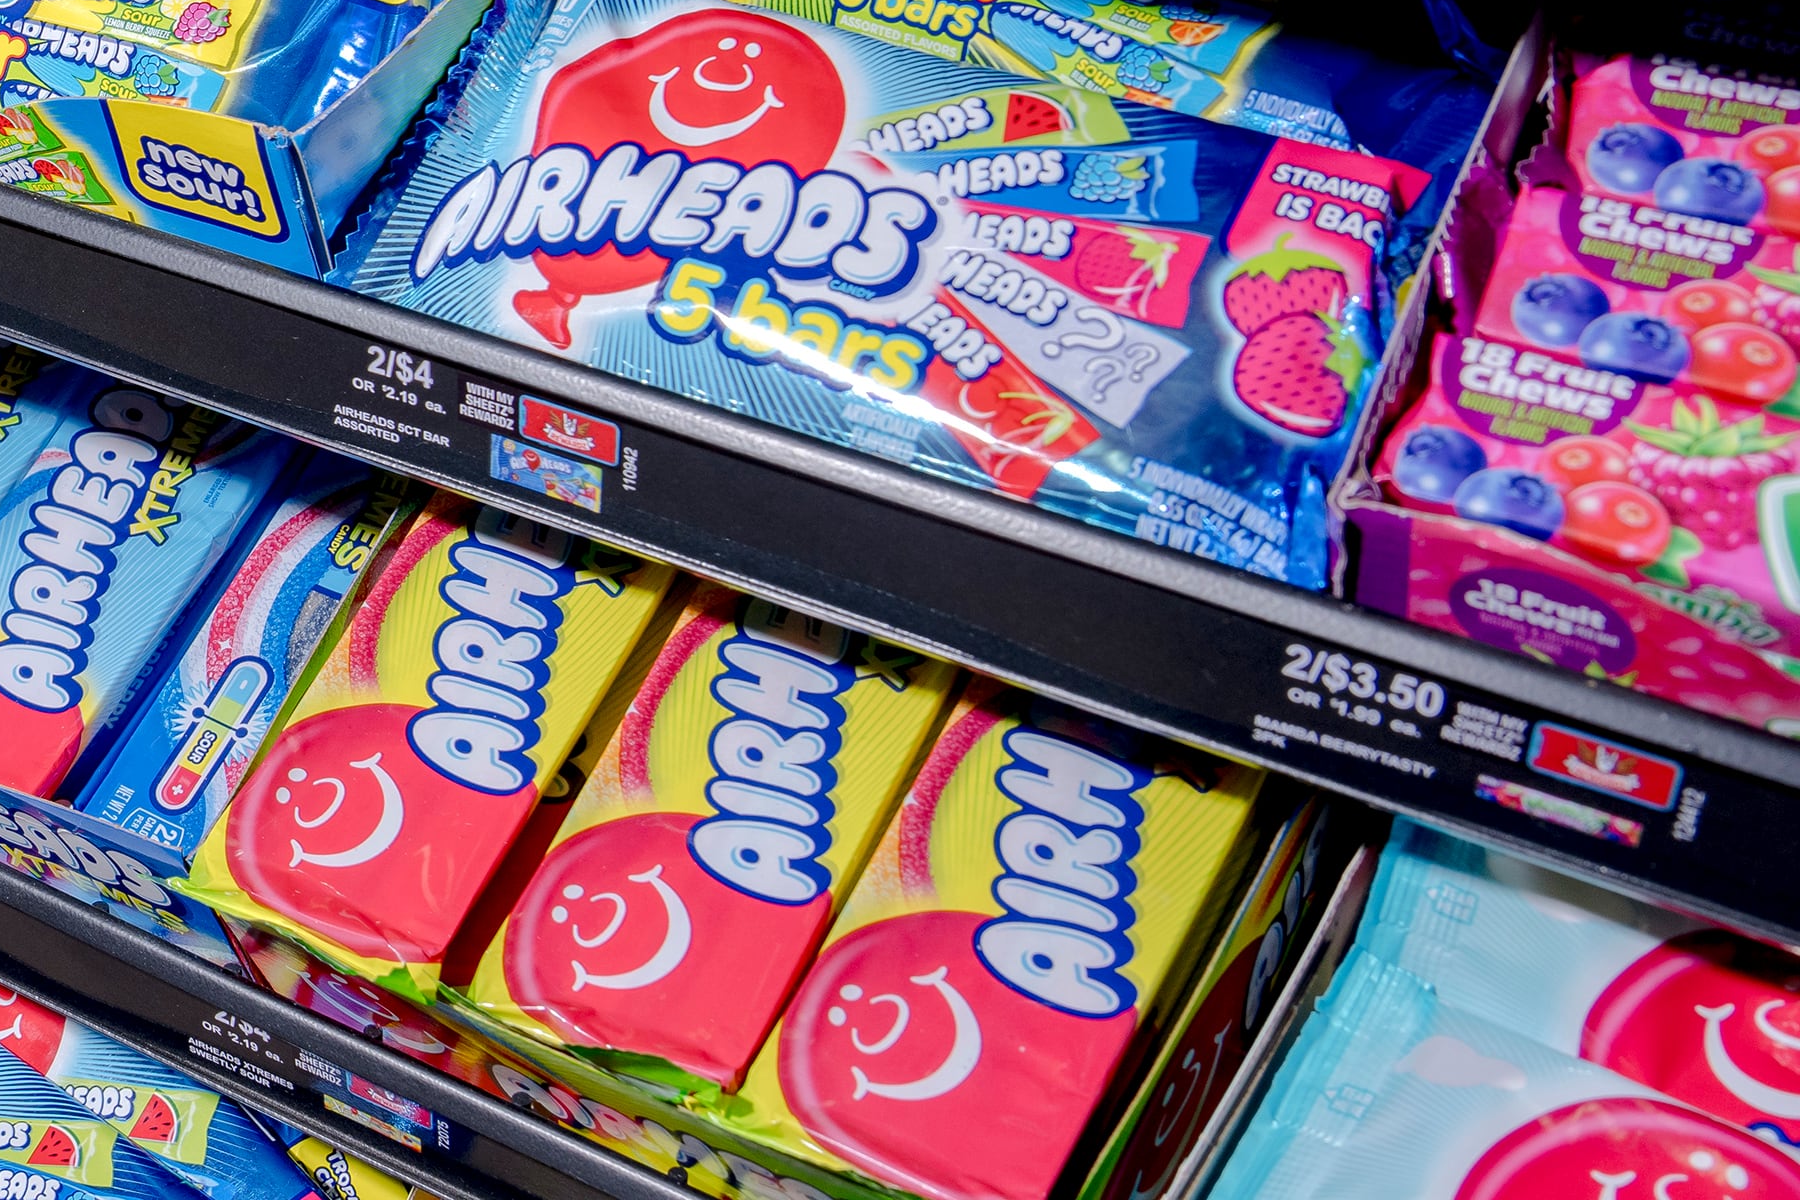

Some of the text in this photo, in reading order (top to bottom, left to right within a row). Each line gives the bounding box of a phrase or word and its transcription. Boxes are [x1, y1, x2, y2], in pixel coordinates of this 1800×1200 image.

[839, 14, 960, 59] ASSORTED FLAVORS
[146, 136, 242, 190] new
[143, 163, 260, 218] sour!
[418, 145, 924, 283] AIRHEADS
[1276, 195, 1384, 247] IS BAC
[658, 260, 928, 393] 5 bars
[352, 377, 376, 394] OR
[366, 344, 434, 391] 2/$4
[1459, 336, 1638, 400] 18 Fruit
[1458, 366, 1616, 421] Chews
[333, 404, 396, 431] AIRHEADS
[422, 430, 450, 448] BAR
[333, 415, 401, 445] ASSORTED
[458, 405, 515, 431] REWARDZ
[622, 446, 639, 492] 110942
[1280, 641, 1446, 719] 2/$3.50
[1286, 685, 1323, 710] OR
[188, 729, 219, 765] SOUR
[1253, 713, 1437, 779] MAMBA BERRYTASTY
[201, 1020, 222, 1036] OR
[187, 1036, 294, 1090] AIRHEADS XTREMES
[188, 1045, 271, 1089] SWEETLY SOUR
[437, 1119, 450, 1150] 72075
